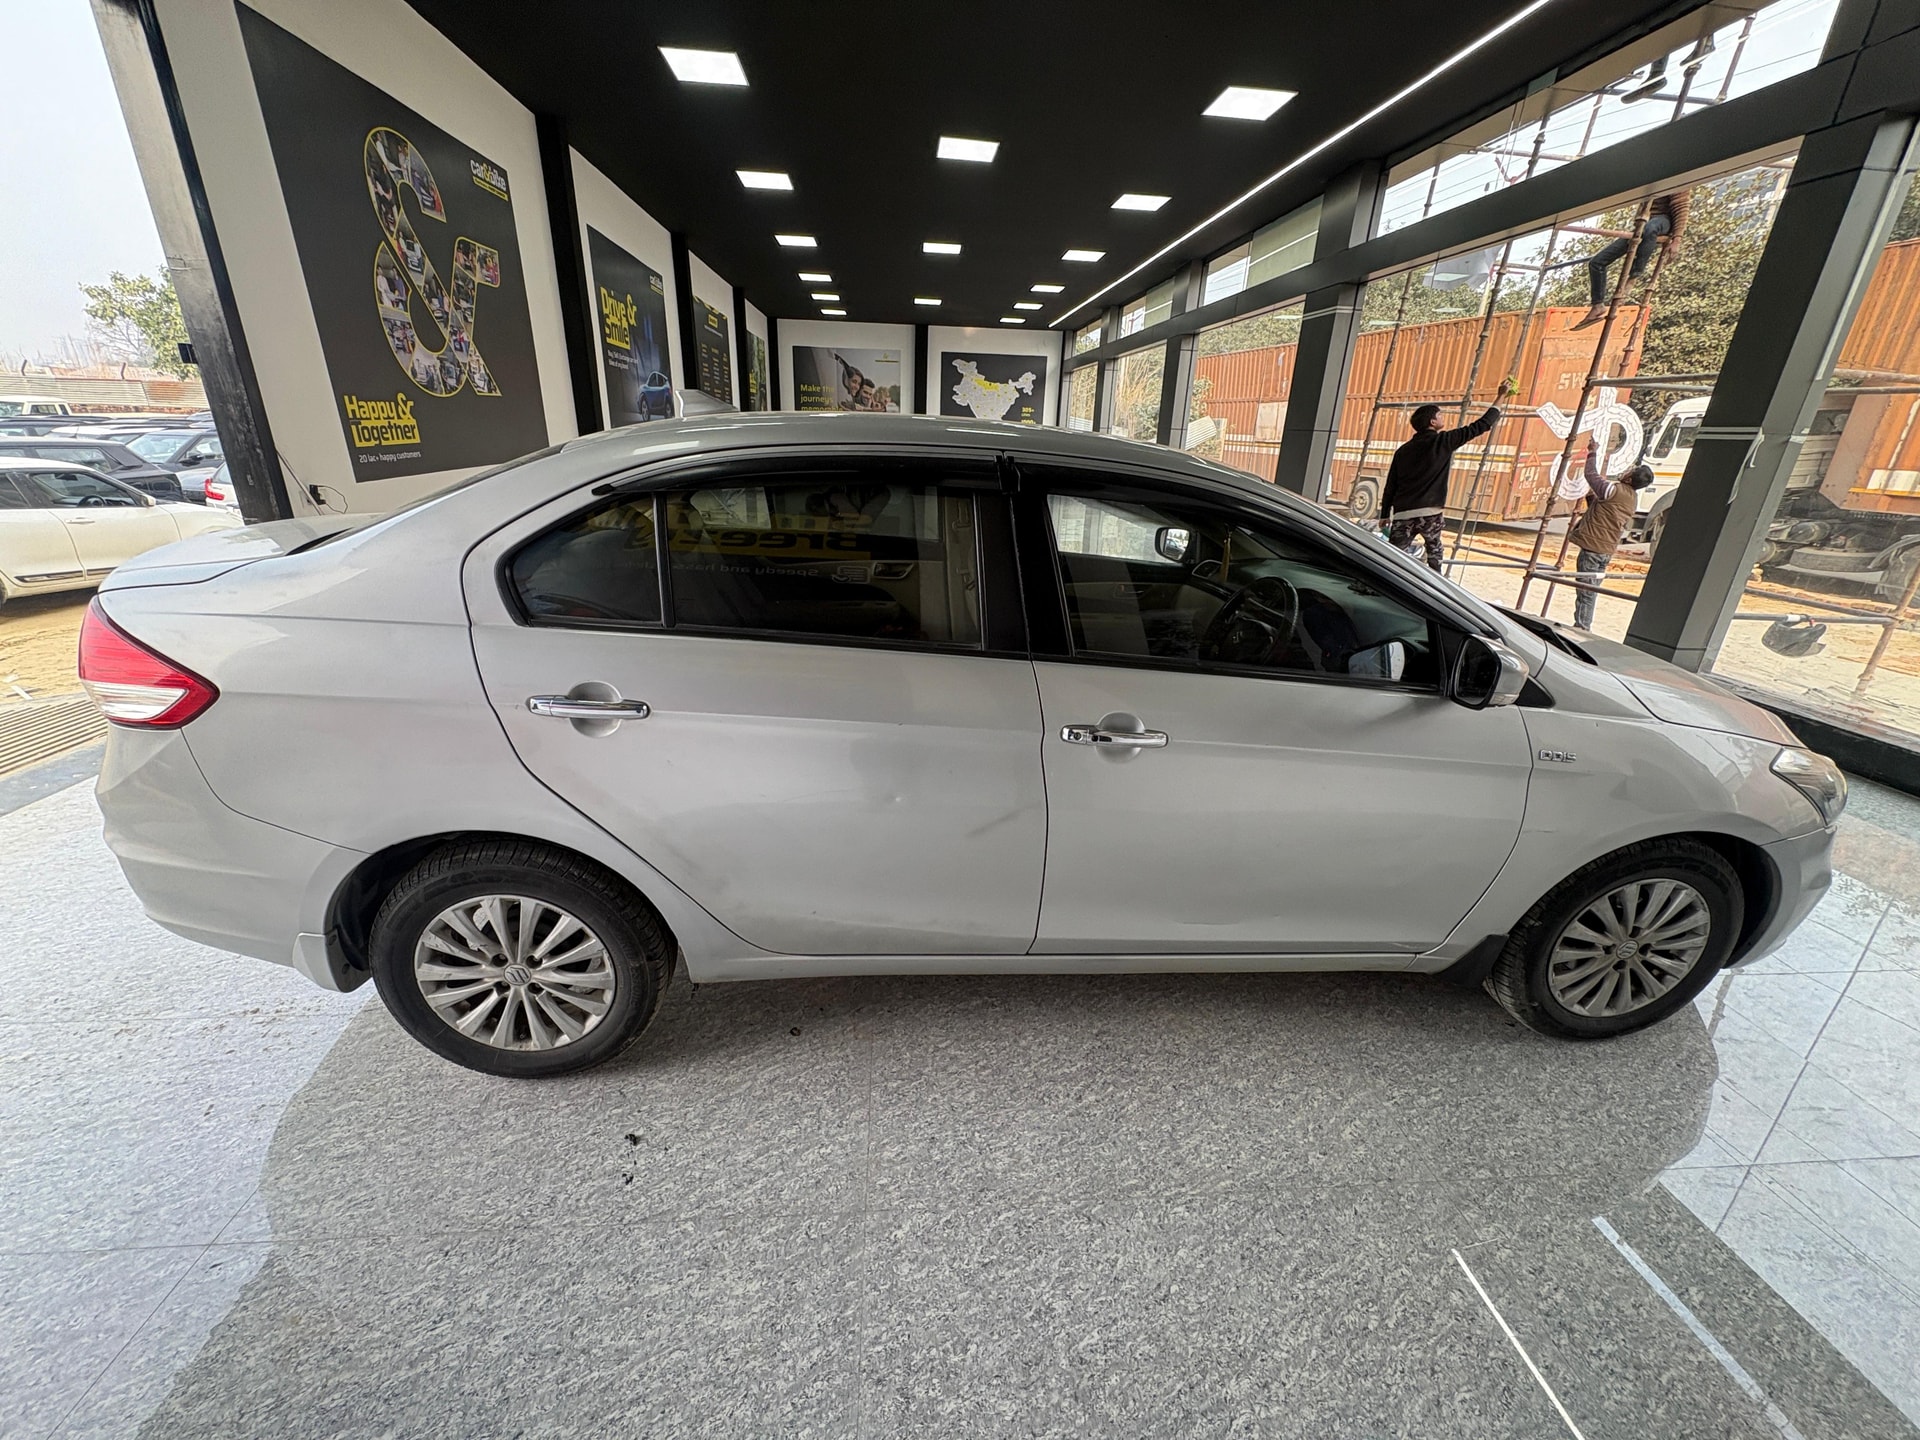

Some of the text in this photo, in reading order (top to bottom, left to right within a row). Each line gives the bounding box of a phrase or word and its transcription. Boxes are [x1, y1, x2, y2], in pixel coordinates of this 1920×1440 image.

[601, 287, 637, 327] Drive &
[800, 384, 821, 392] Make
[343, 393, 416, 420] Happy &
[800, 394, 834, 405] journeys
[350, 420, 416, 445] Together
[358, 453, 368, 463] 20
[379, 452, 398, 462] happy
[396, 451, 422, 460] customers
